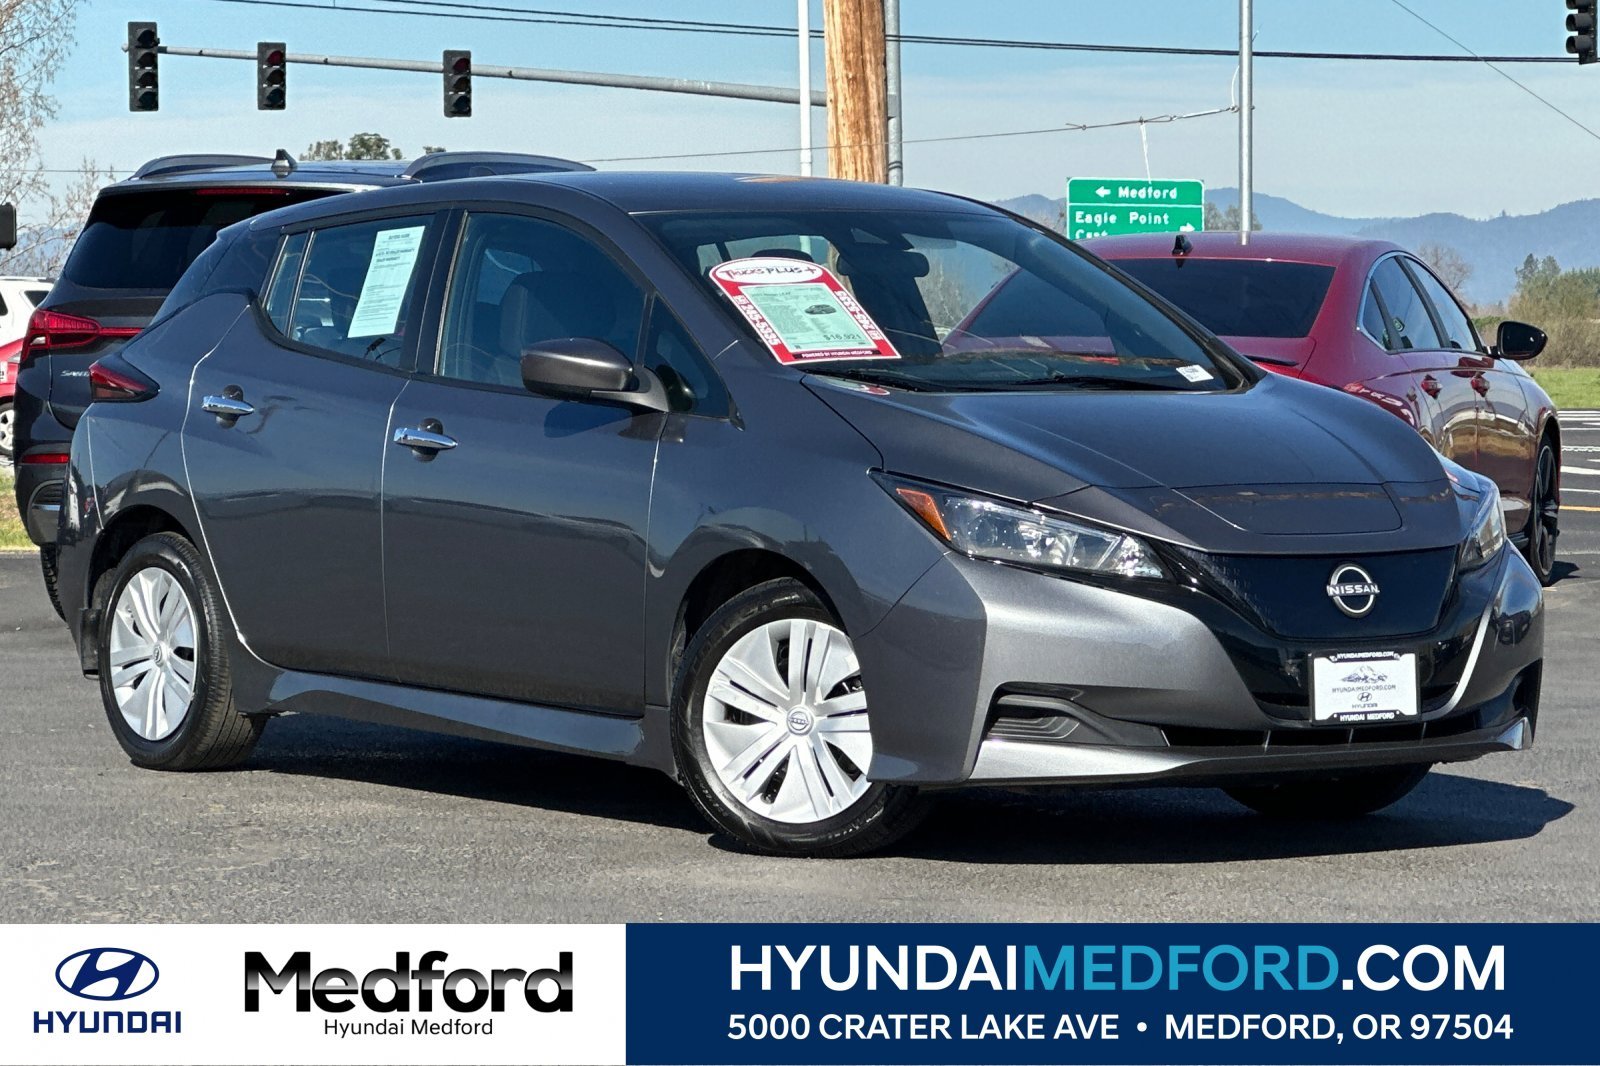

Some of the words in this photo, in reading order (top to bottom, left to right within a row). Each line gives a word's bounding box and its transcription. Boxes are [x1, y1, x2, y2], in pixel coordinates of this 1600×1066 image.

[1118, 186, 1178, 199] Medford
[1075, 210, 1117, 227] Eagle
[1129, 211, 1169, 224] Point
[1327, 584, 1379, 596] NISSAN
